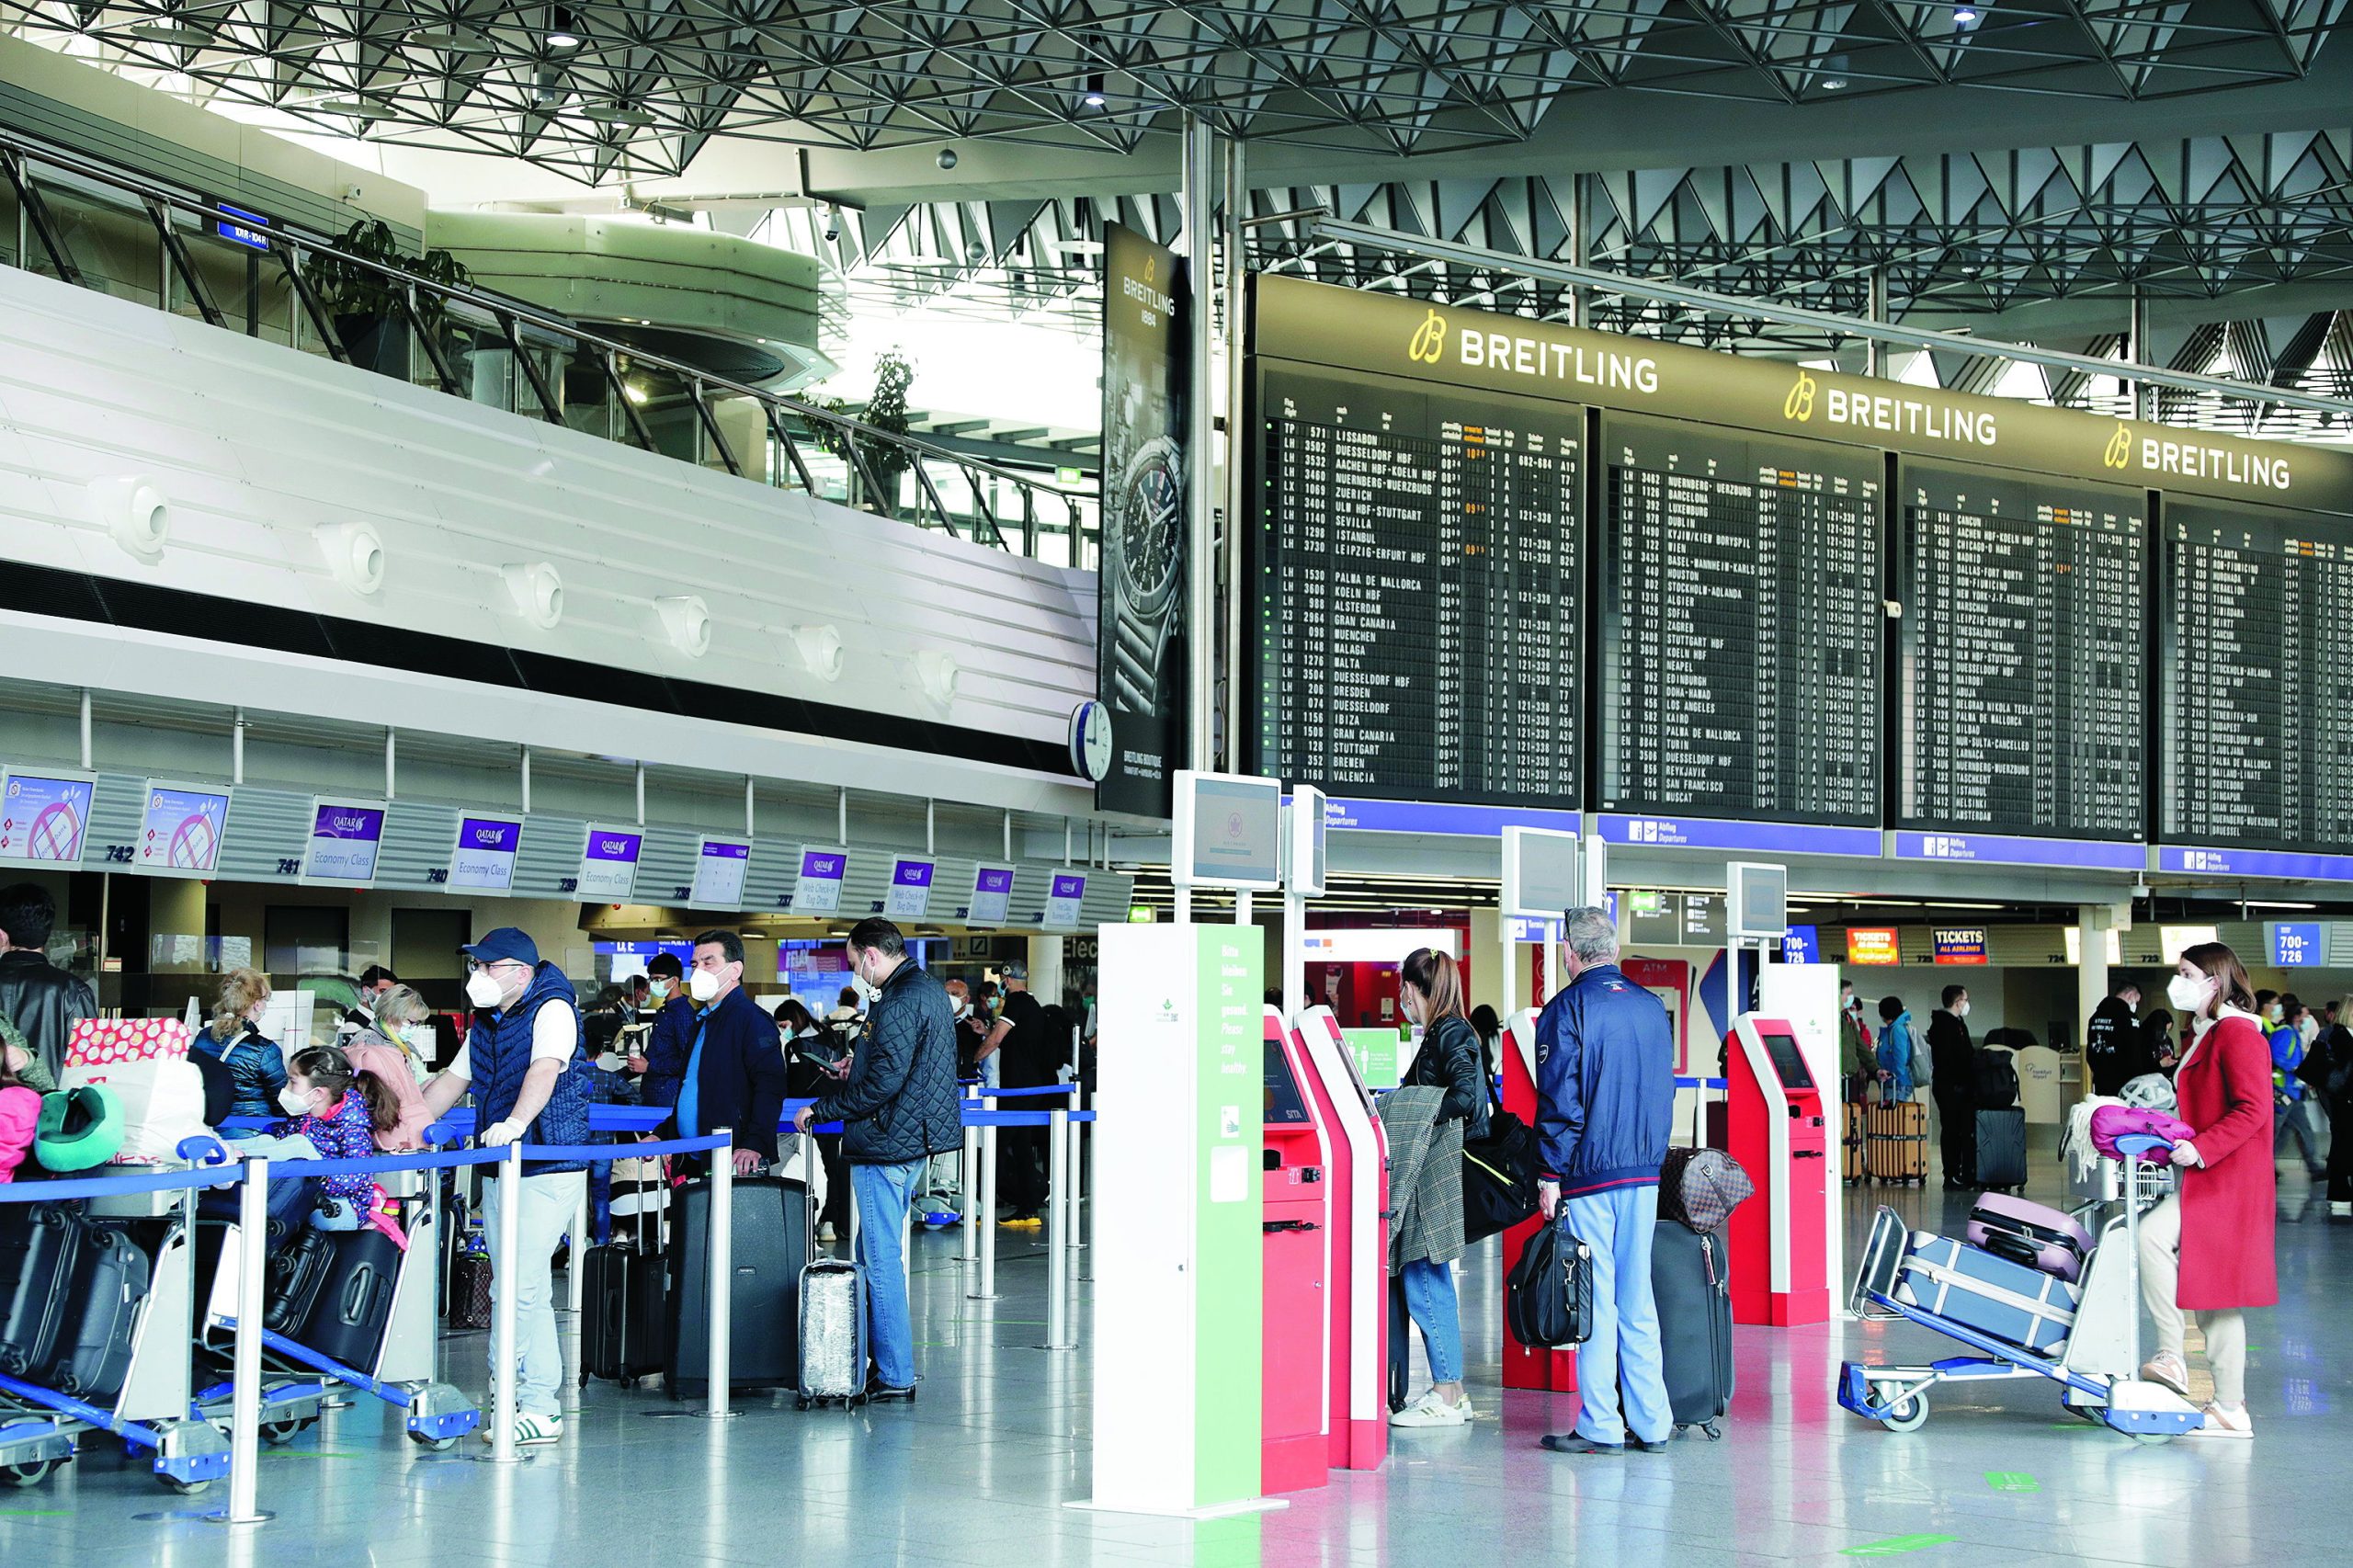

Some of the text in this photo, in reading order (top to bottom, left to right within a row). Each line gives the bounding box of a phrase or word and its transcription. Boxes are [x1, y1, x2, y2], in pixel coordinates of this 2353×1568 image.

[1123, 276, 1176, 316] BREITLING
[1141, 309, 1156, 327] 1884
[1460, 328, 1659, 394] BREITLING
[1827, 388, 1997, 447] BREITLING
[1284, 423, 1377, 446] TP 571 LISSABON
[1336, 444, 1412, 464] DUESSELDORF HBF
[1336, 458, 1366, 472] AACHEN
[1422, 470, 1437, 482] HBF
[2142, 437, 2290, 490] BREITLING
[1283, 480, 1371, 501] LX 1069 ZUERICH
[1667, 489, 1708, 504] BARCELONA
[1335, 501, 1350, 513] ULM
[1667, 502, 1708, 517] LUXEMBURG
[1335, 515, 1371, 529] SEVILLA
[1667, 515, 1694, 528] DUBLIN
[1335, 528, 1376, 543] ISTANBUL
[1716, 534, 1751, 548] BORYSPIL
[1667, 541, 1685, 553] WIEN
[1411, 551, 1427, 563] HBF
[1335, 572, 1421, 590] PALMA DE MALLORCA
[1667, 568, 1699, 581] HOUSTON
[1335, 585, 1381, 600] KOELN HBF
[1667, 594, 1694, 607] ALGIER
[1667, 607, 1689, 619] SOFIA
[1335, 614, 1396, 630] GRAN CANARIA
[1666, 620, 1693, 632] ZAGREB
[1335, 628, 1375, 642] MUENCHEN
[1956, 625, 2003, 639] THESSALONIKI
[1666, 633, 1724, 648] STUTTGART HBF
[1334, 642, 1365, 655] MALAGA
[1334, 656, 1359, 669] MALTA
[1666, 660, 1693, 672] NEAPEL
[1334, 671, 1411, 687] DUESSELDORF HBF
[1666, 673, 1706, 686] EDINBURGH
[1956, 675, 1984, 686] NAIROBI
[1334, 685, 1370, 698] DRESDEN
[1334, 699, 1390, 713] DUESSELDORF
[1666, 699, 1715, 712] LOS ANGELES
[1334, 713, 1359, 725] IBIZA
[1666, 712, 1688, 723] KAIRO
[1334, 727, 1395, 742] GRAN CANARIA
[1956, 723, 1979, 734] BILBAO
[1334, 742, 1380, 755] STUTTGART
[1665, 738, 1688, 749] TURIN
[1334, 756, 1364, 767] BREMEN
[1333, 770, 1374, 782] VALENCIA
[1665, 765, 1706, 777] REYKJAVIK
[1665, 778, 1722, 790] SAN FRANCISCO
[1956, 773, 1991, 784] TASCHKENT
[1665, 791, 1692, 801] MUSCAT
[1956, 785, 1986, 796] ISTANBUL
[1956, 798, 1986, 809] HELSINKI
[1955, 810, 1991, 821] AMSTERDAM
[1658, 822, 1677, 834] Abflug
[1658, 833, 1688, 844] Departures
[106, 845, 135, 862] 742
[314, 852, 369, 868] Economy Class
[278, 858, 301, 874] 741
[459, 861, 507, 877] Economy Class
[427, 868, 448, 883] 740
[585, 871, 629, 886] Economy Class
[559, 878, 578, 892] 739
[803, 883, 835, 894] Web Check-in
[805, 894, 816, 906] Bag
[1785, 937, 1808, 950] 700-
[1936, 930, 1984, 944] TICKETS
[2279, 936, 2309, 949] 700-
[1221, 945, 1239, 957] Bitte
[1787, 952, 1805, 963] 726
[2279, 950, 2302, 963] 726
[2048, 954, 2064, 963] 724
[1221, 964, 1247, 977] bleiben
[1643, 963, 1667, 972] ATM
[1221, 983, 1233, 996] Sie
[1221, 1003, 1248, 1017] gesund.
[1221, 1022, 1244, 1035] Please
[1221, 1043, 1236, 1055] stay
[1221, 1060, 1248, 1075] healthy.
[1285, 1108, 1302, 1119] SITA
